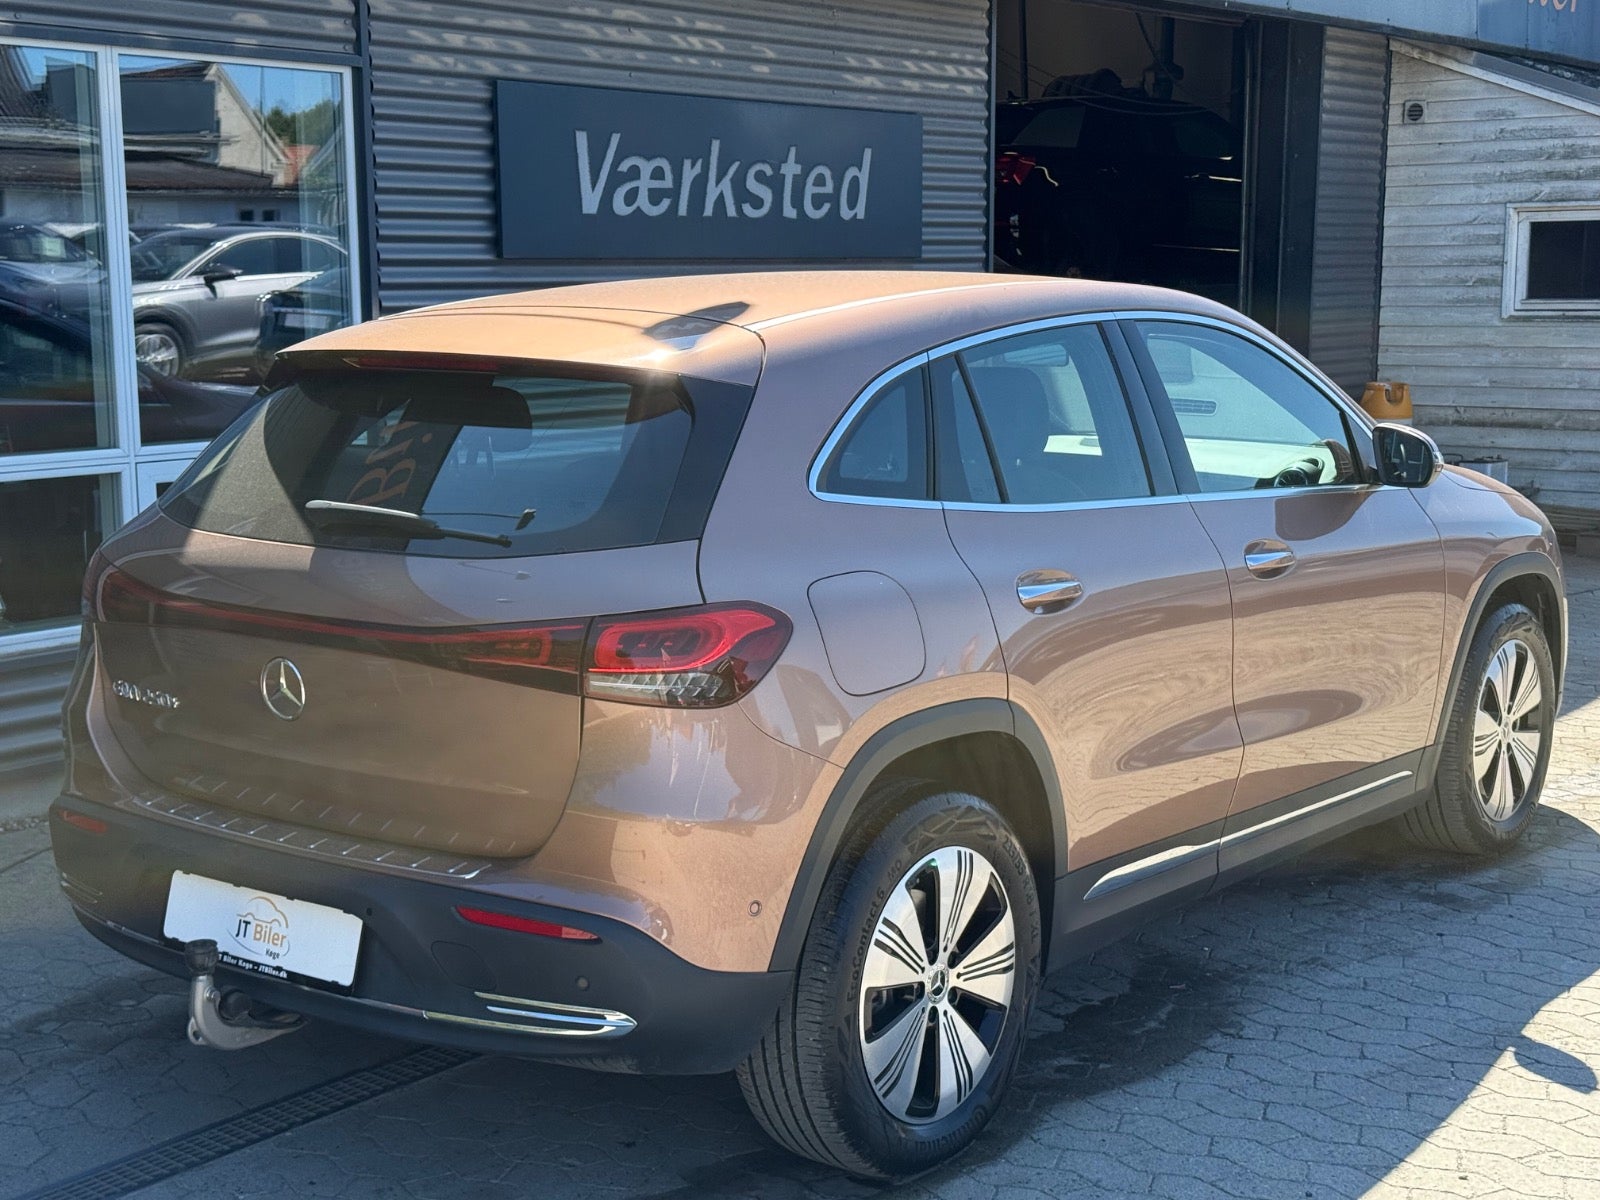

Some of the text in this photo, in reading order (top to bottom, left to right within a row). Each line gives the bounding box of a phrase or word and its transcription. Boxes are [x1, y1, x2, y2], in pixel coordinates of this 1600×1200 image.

[574, 129, 873, 221] Værksted
[236, 919, 287, 947] JT Biler
